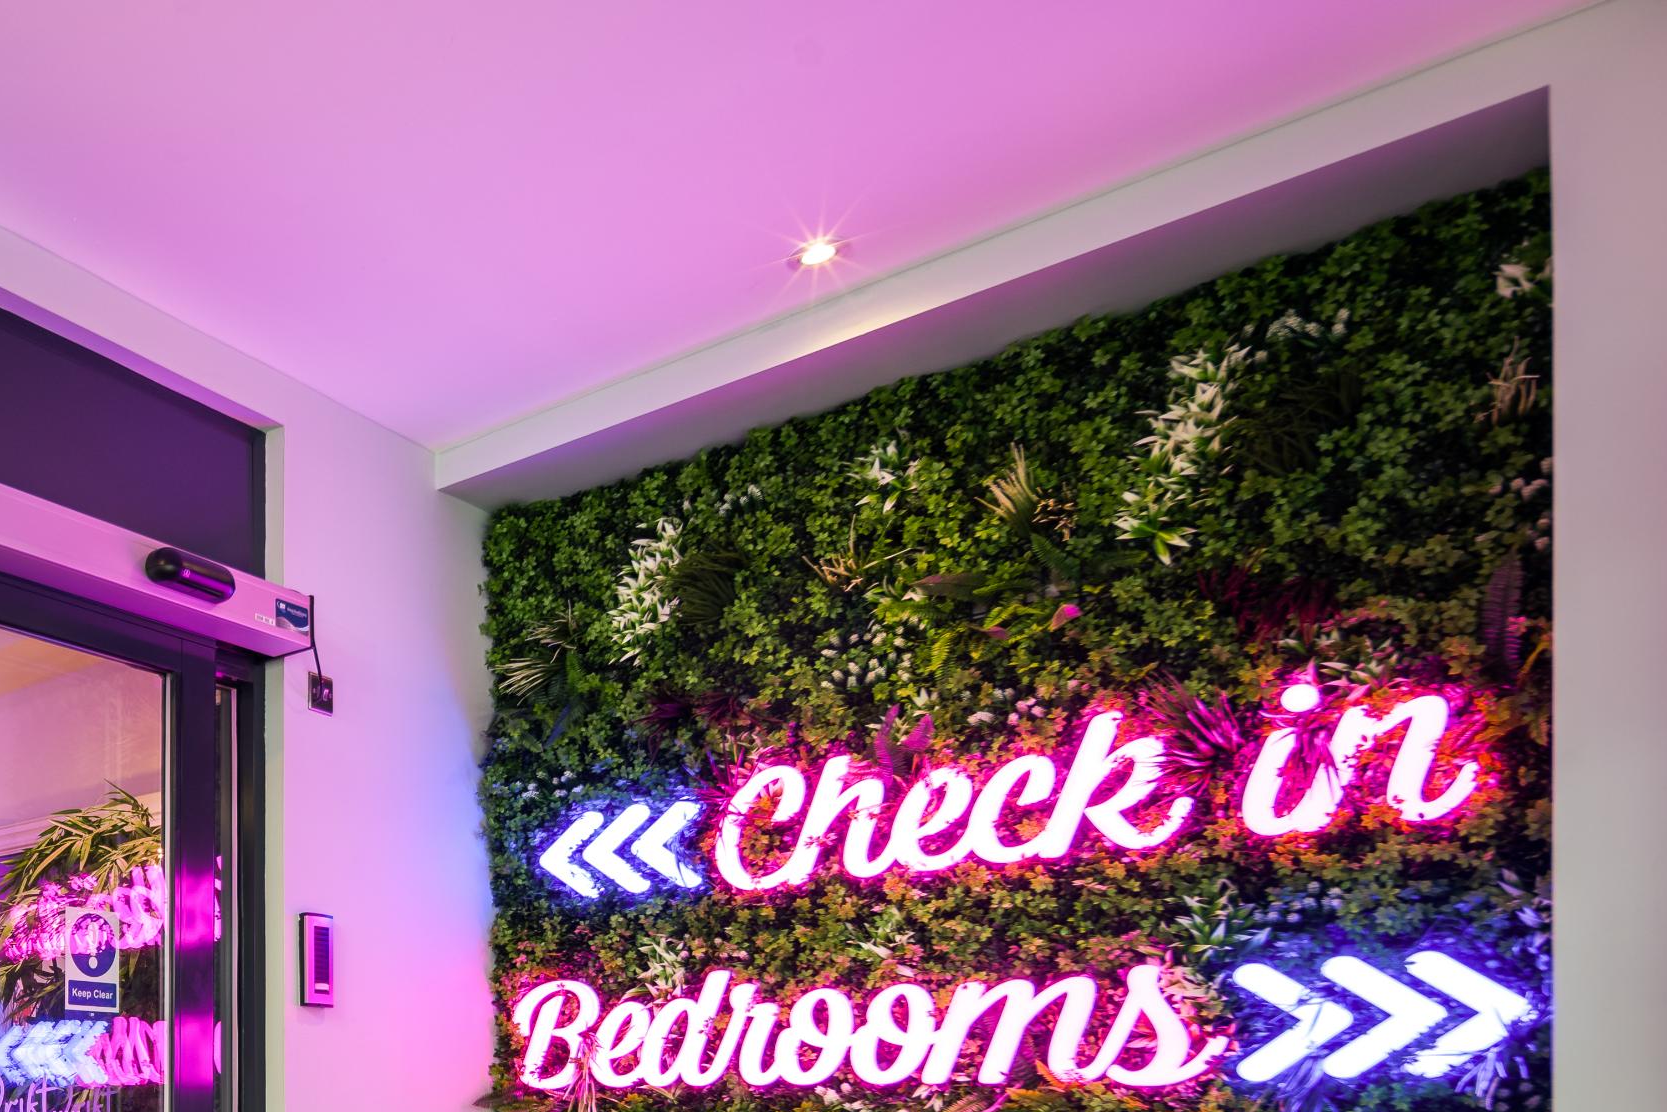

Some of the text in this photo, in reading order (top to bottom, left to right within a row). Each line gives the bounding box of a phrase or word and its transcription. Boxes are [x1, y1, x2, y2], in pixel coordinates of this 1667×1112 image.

[714, 684, 1480, 891] Check in
[72, 988, 113, 1000] Keep Clear
[514, 964, 1230, 1090] Bedrooms
